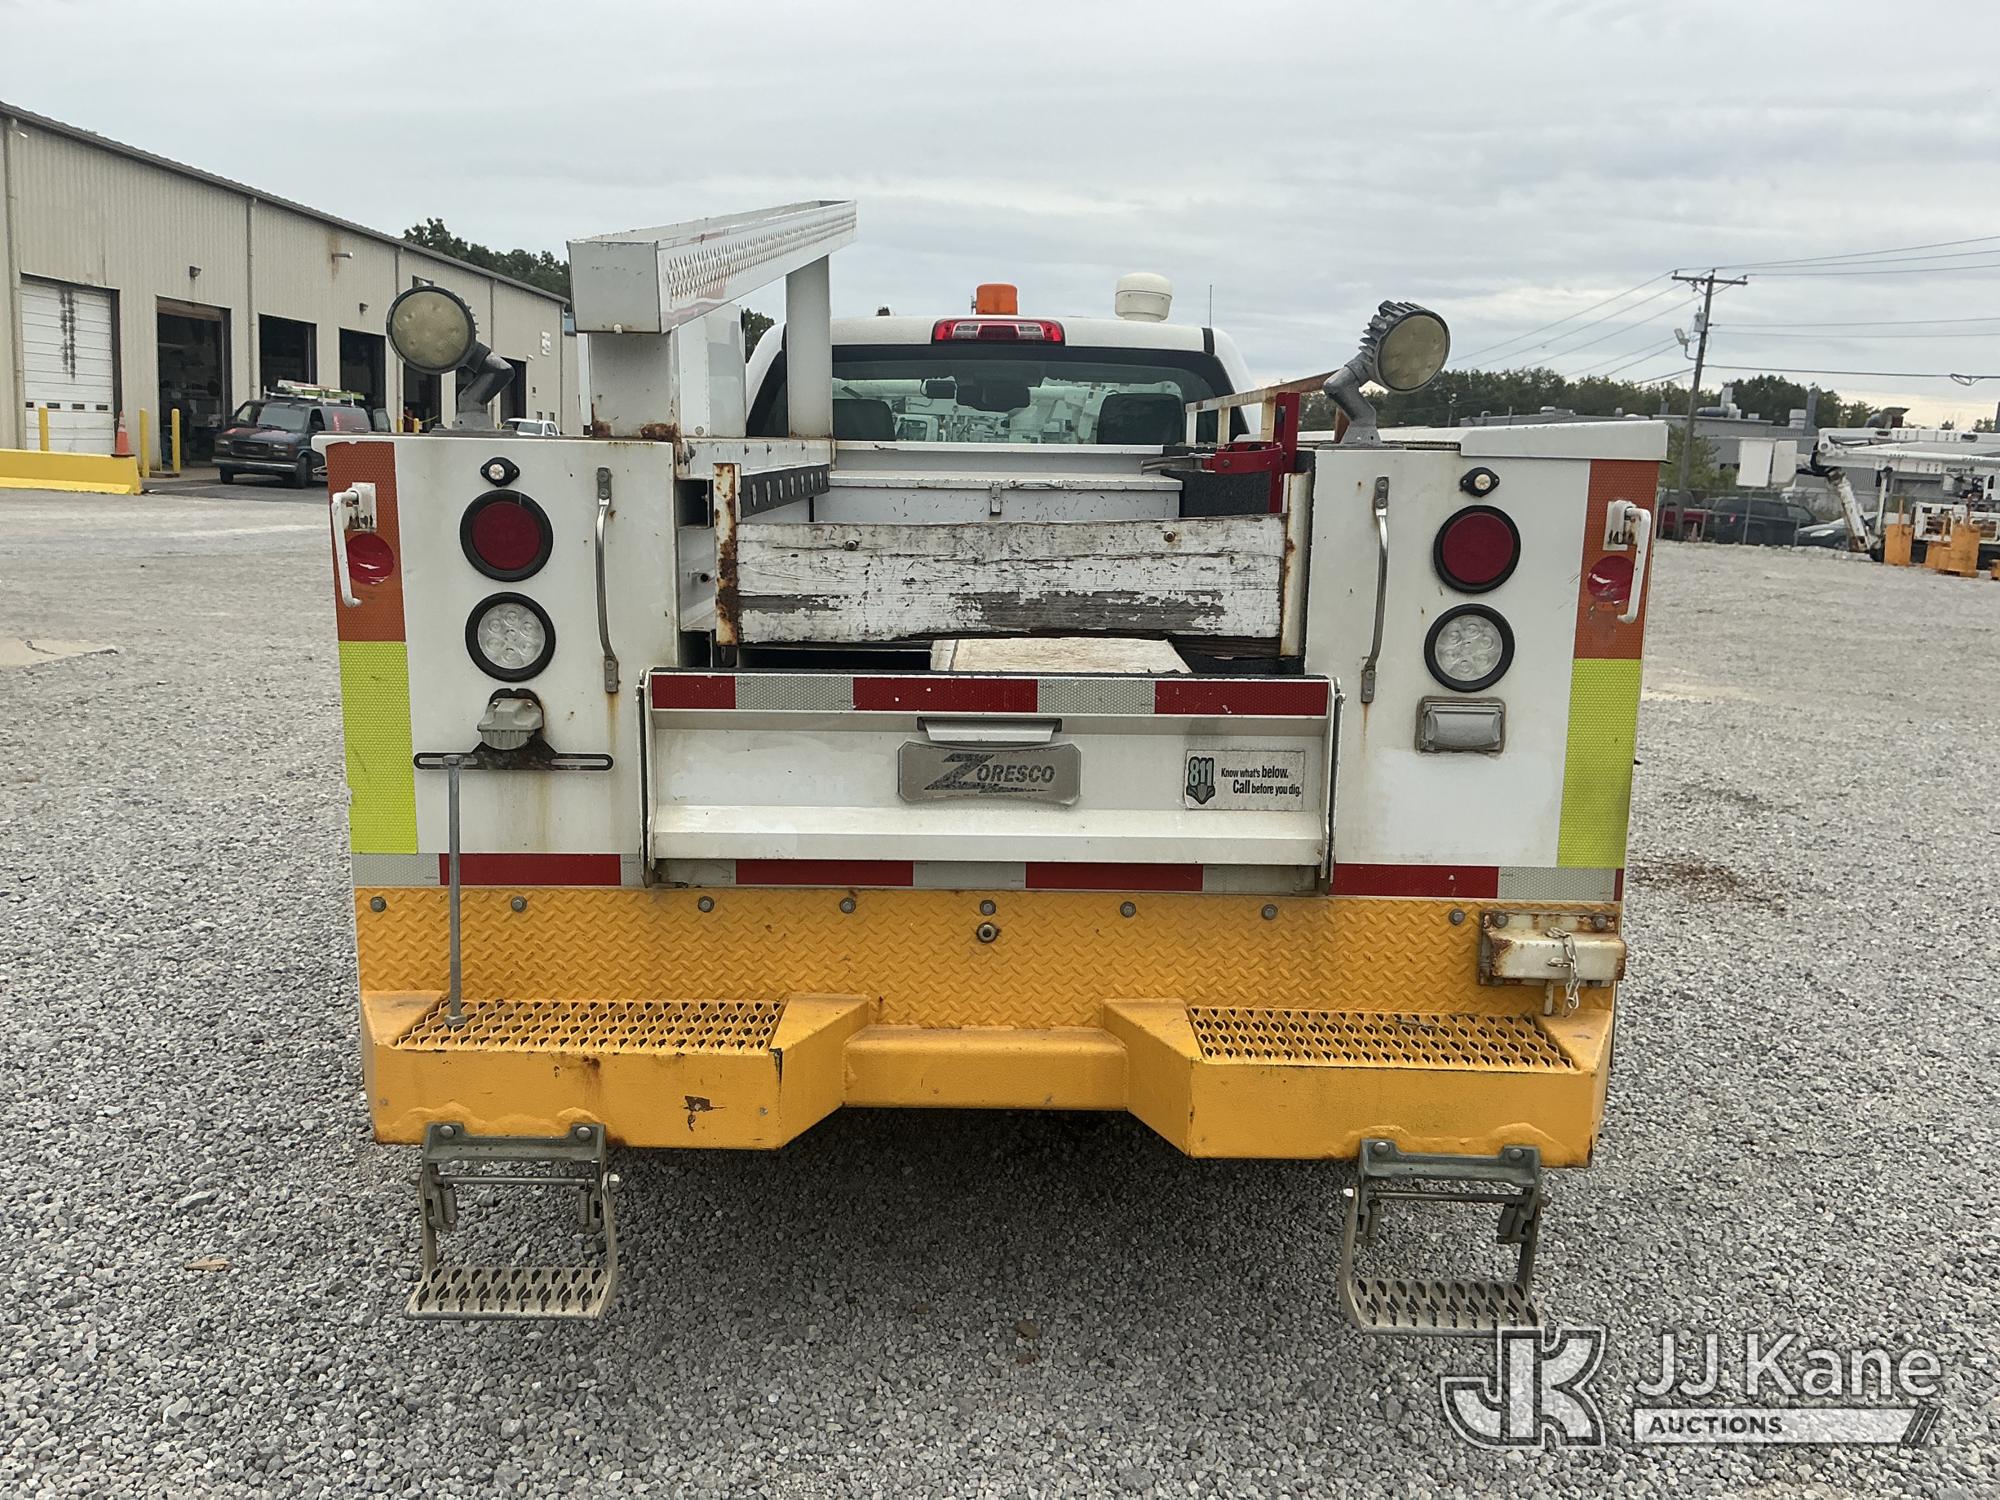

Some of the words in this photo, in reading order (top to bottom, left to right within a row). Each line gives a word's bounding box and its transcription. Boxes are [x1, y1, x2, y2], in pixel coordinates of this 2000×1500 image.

[924, 752, 1056, 793] ZORESCO
[1187, 756, 1215, 788] 811
[1221, 767, 1239, 778] Know
[1240, 767, 1261, 778] what's
[1262, 765, 1289, 779] below.
[1232, 779, 1251, 794] Call
[1251, 783, 1275, 795] before
[1275, 785, 1288, 797] you
[1288, 783, 1302, 797] dig.
